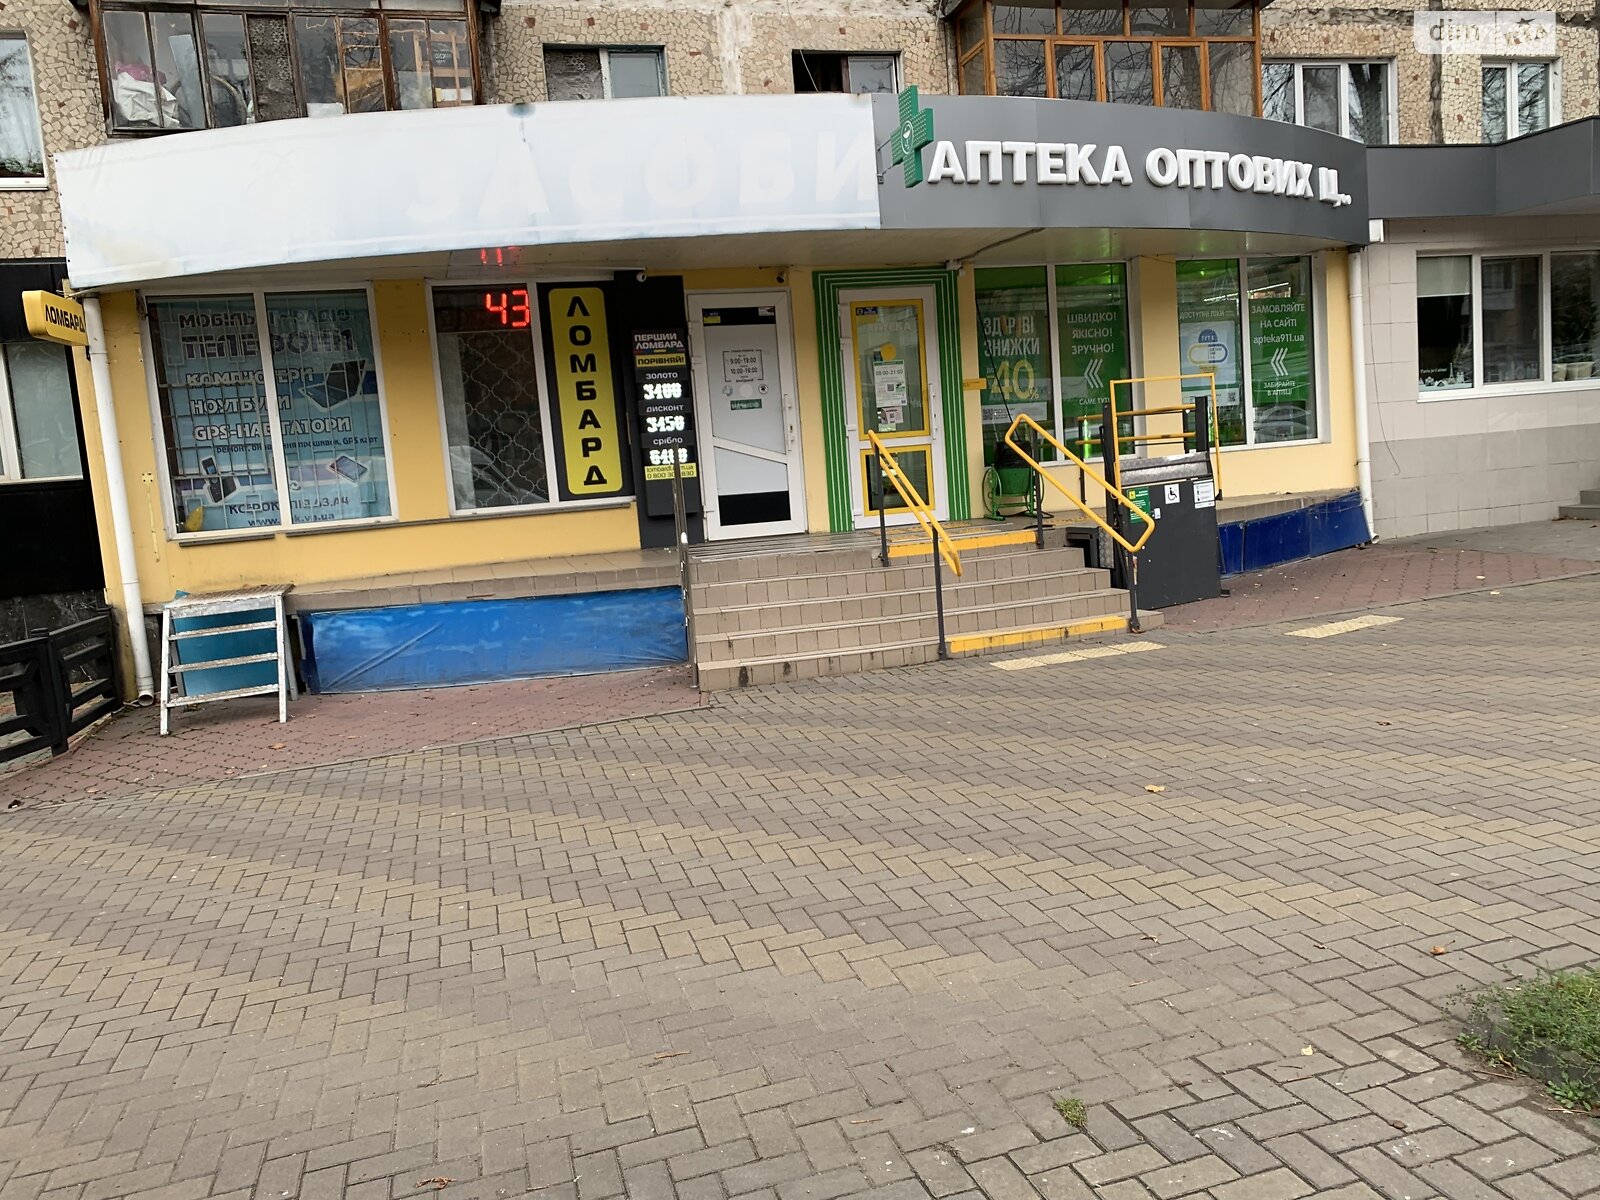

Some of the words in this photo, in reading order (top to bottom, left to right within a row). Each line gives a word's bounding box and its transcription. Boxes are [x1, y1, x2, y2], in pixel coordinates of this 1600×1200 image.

[927, 140, 1133, 186] АПТЕКА
[1145, 147, 1314, 199] ОПТОВИХ
[485, 290, 530, 328] 43
[1251, 302, 1305, 314] ЗАМОВЛЯЙТЕ
[45, 304, 86, 333] ЛОМБАРД
[1067, 312, 1117, 324] ШВИДКО!
[1260, 320, 1271, 328] НА
[1273, 317, 1297, 328] САЙТІ
[1072, 328, 1113, 339] ЯКІСНО!
[1253, 333, 1305, 346] apteka911.ua
[636, 341, 684, 350] ЛОМБАРД
[983, 337, 1040, 357] ЗНИЖКИ
[1072, 343, 1115, 355] ЗРУЧНО!
[638, 356, 685, 365] ПОРІВНЯЙ!
[566, 296, 607, 486] ЛОМБАРД
[190, 395, 292, 415] НОУТБУИ
[194, 416, 353, 441] GPS-НАВГАТОРИ
